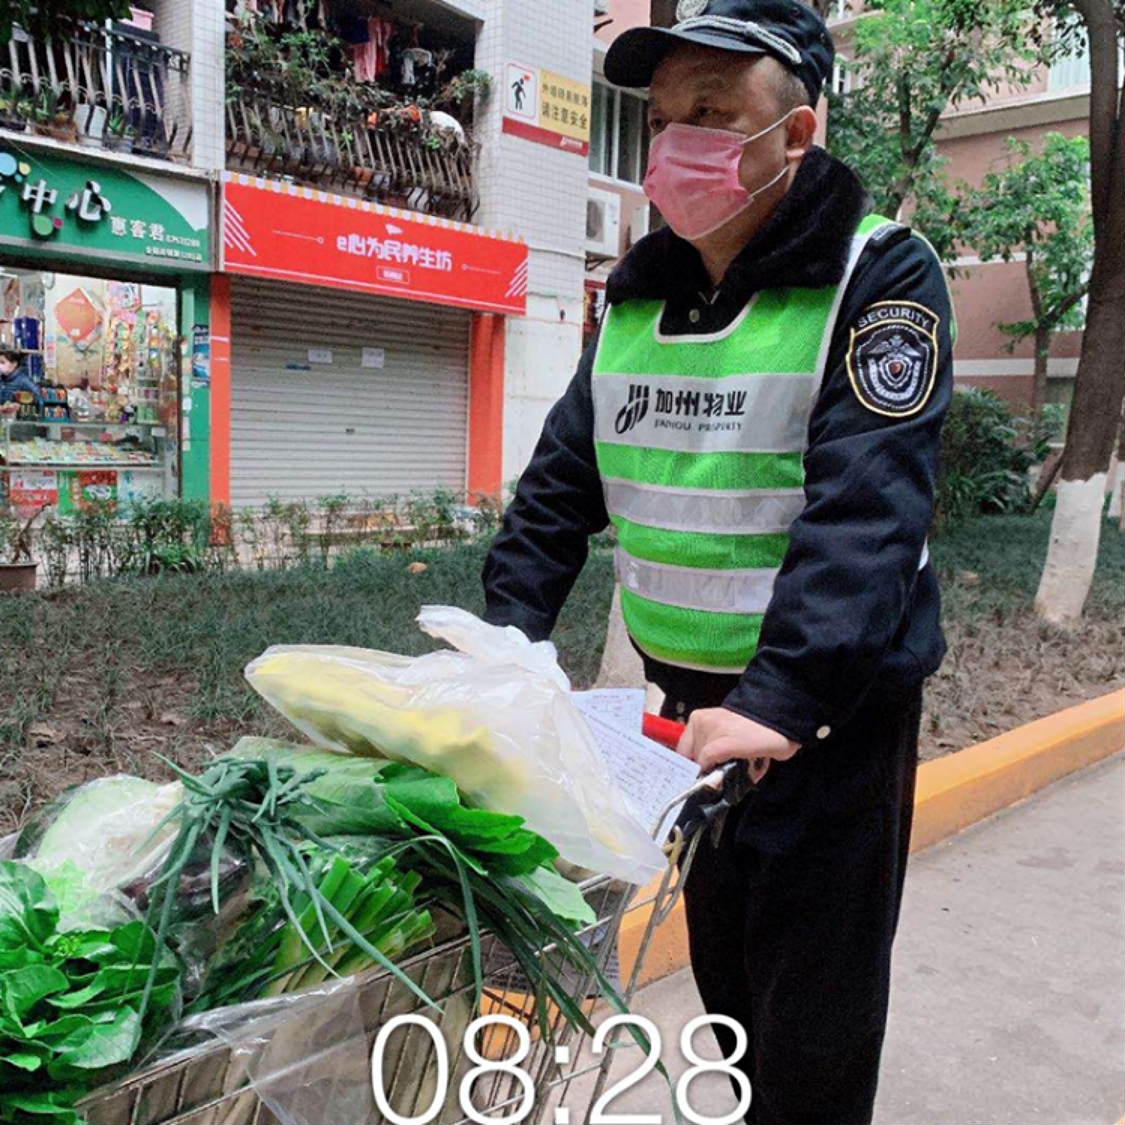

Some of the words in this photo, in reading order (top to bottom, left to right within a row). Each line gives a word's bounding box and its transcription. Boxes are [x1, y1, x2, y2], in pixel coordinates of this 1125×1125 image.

[858, 307, 929, 329] SECURITY
[655, 388, 747, 417] 加州物业
